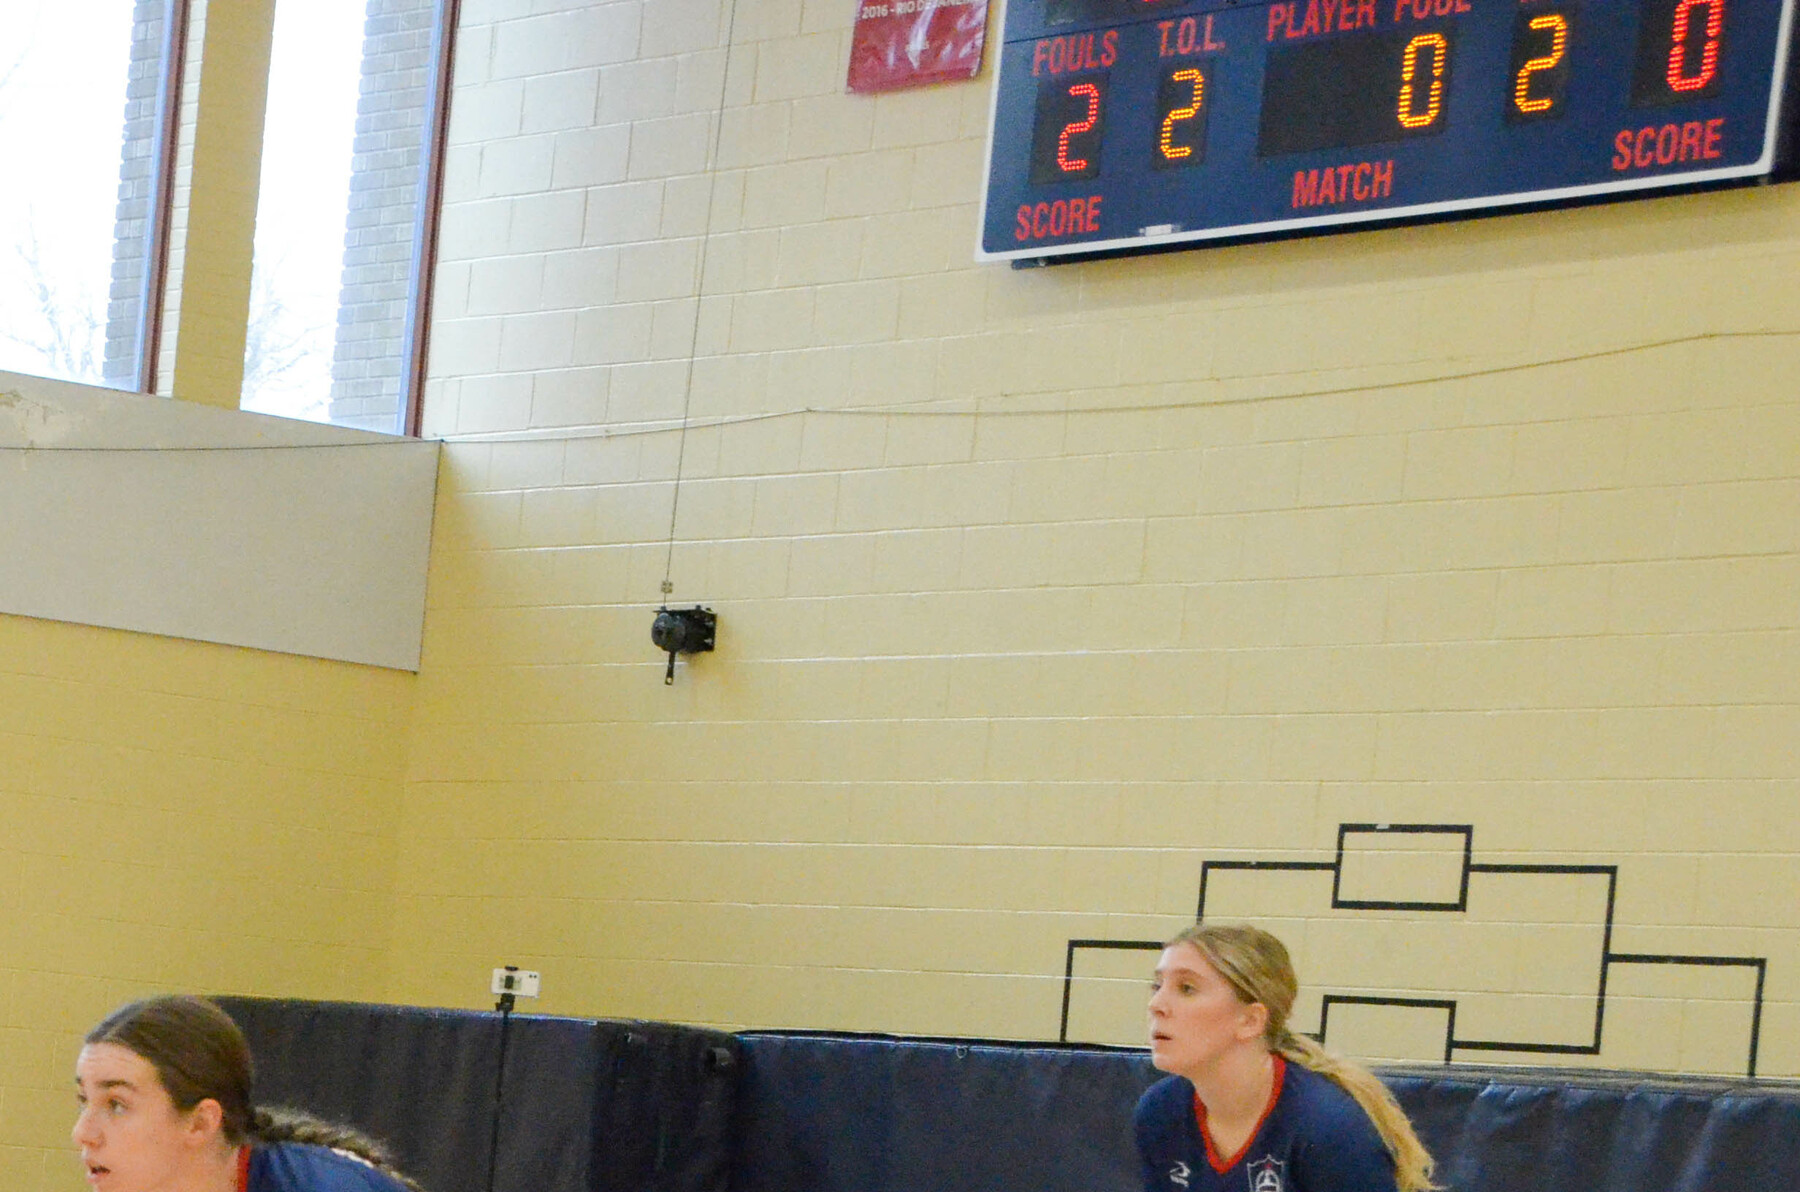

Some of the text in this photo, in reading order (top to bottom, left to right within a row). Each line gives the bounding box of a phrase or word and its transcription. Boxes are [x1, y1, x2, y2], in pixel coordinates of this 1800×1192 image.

[862, 4, 888, 19] 2016
[1157, 15, 1226, 57] T.O.L.
[1266, 0, 1377, 41] PLAYER
[1032, 30, 1119, 77] FOULS
[1514, 14, 1567, 113] 2
[1666, 0, 1724, 92] 0
[1397, 33, 1447, 128] 0
[1057, 83, 1099, 172] 2
[1160, 68, 1204, 159] 2
[1612, 117, 1726, 171] SCORE
[1291, 160, 1394, 209] MATCH
[1014, 195, 1103, 241] SCORE
